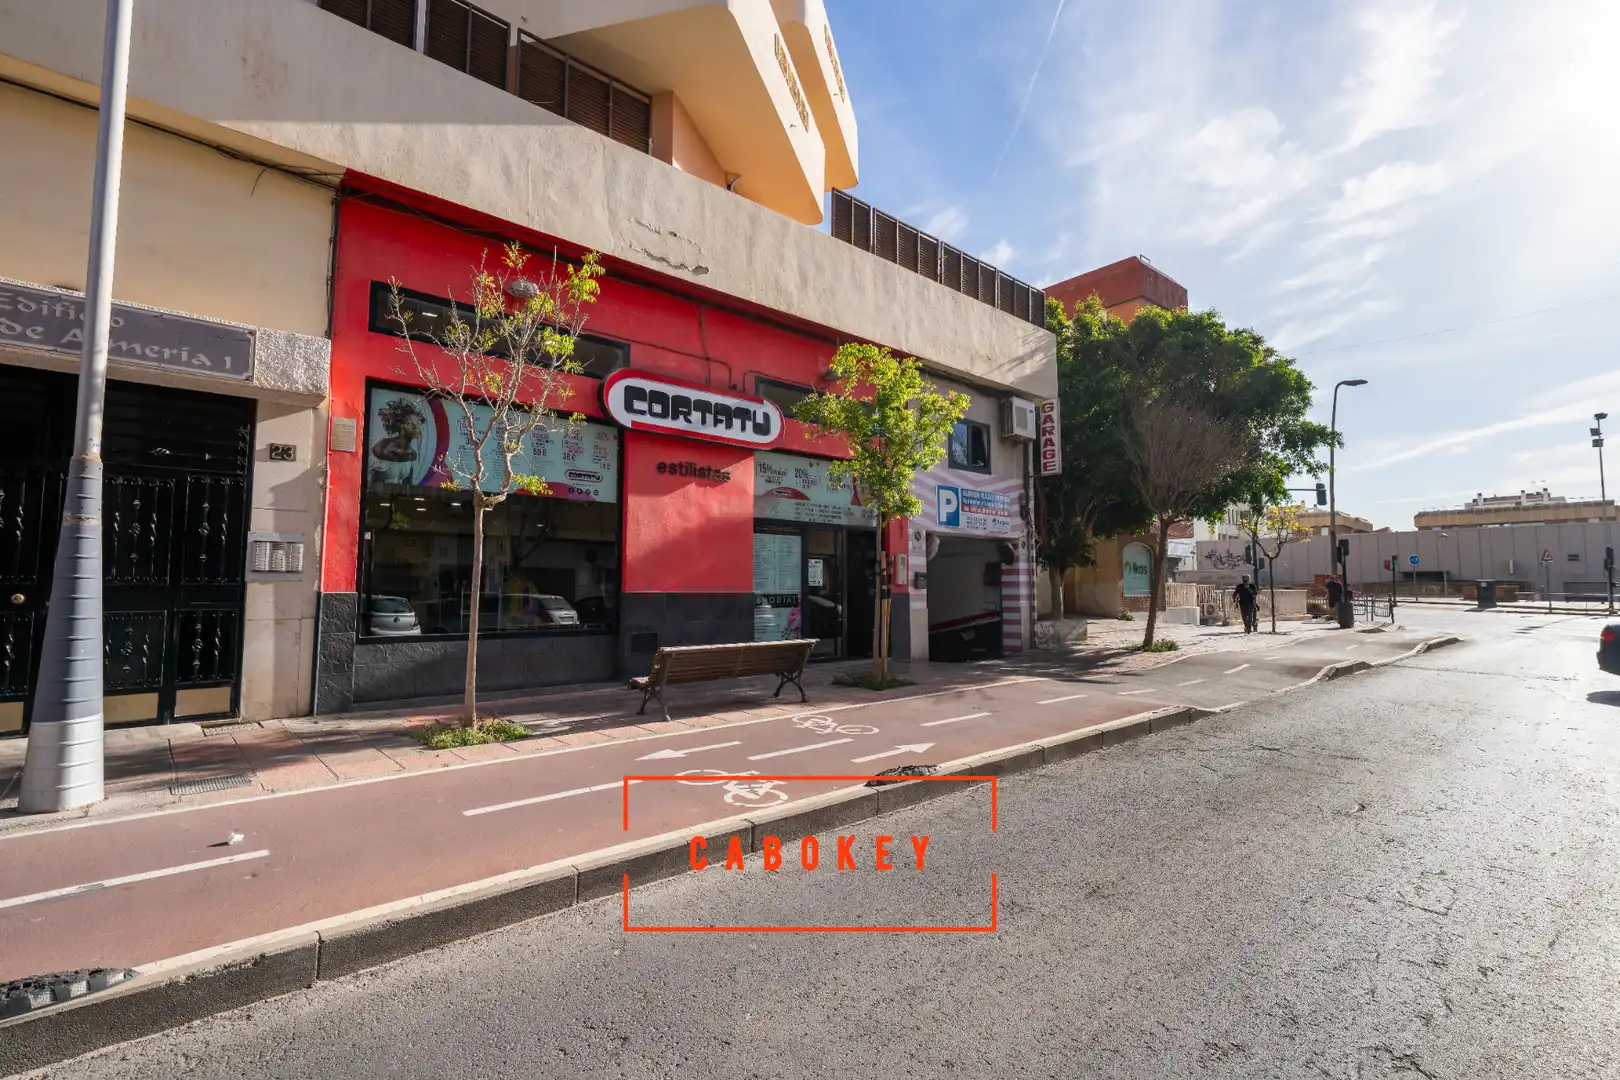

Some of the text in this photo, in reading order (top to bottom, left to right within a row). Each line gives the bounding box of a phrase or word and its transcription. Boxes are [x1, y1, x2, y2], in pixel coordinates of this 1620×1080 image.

[0, 291, 125, 327] Edifio
[0, 317, 44, 339] de
[624, 384, 772, 436] CORTATU
[271, 445, 294, 460] 23
[1041, 402, 1056, 472] GARAGE
[656, 459, 732, 482] estilistas
[939, 489, 957, 522] P
